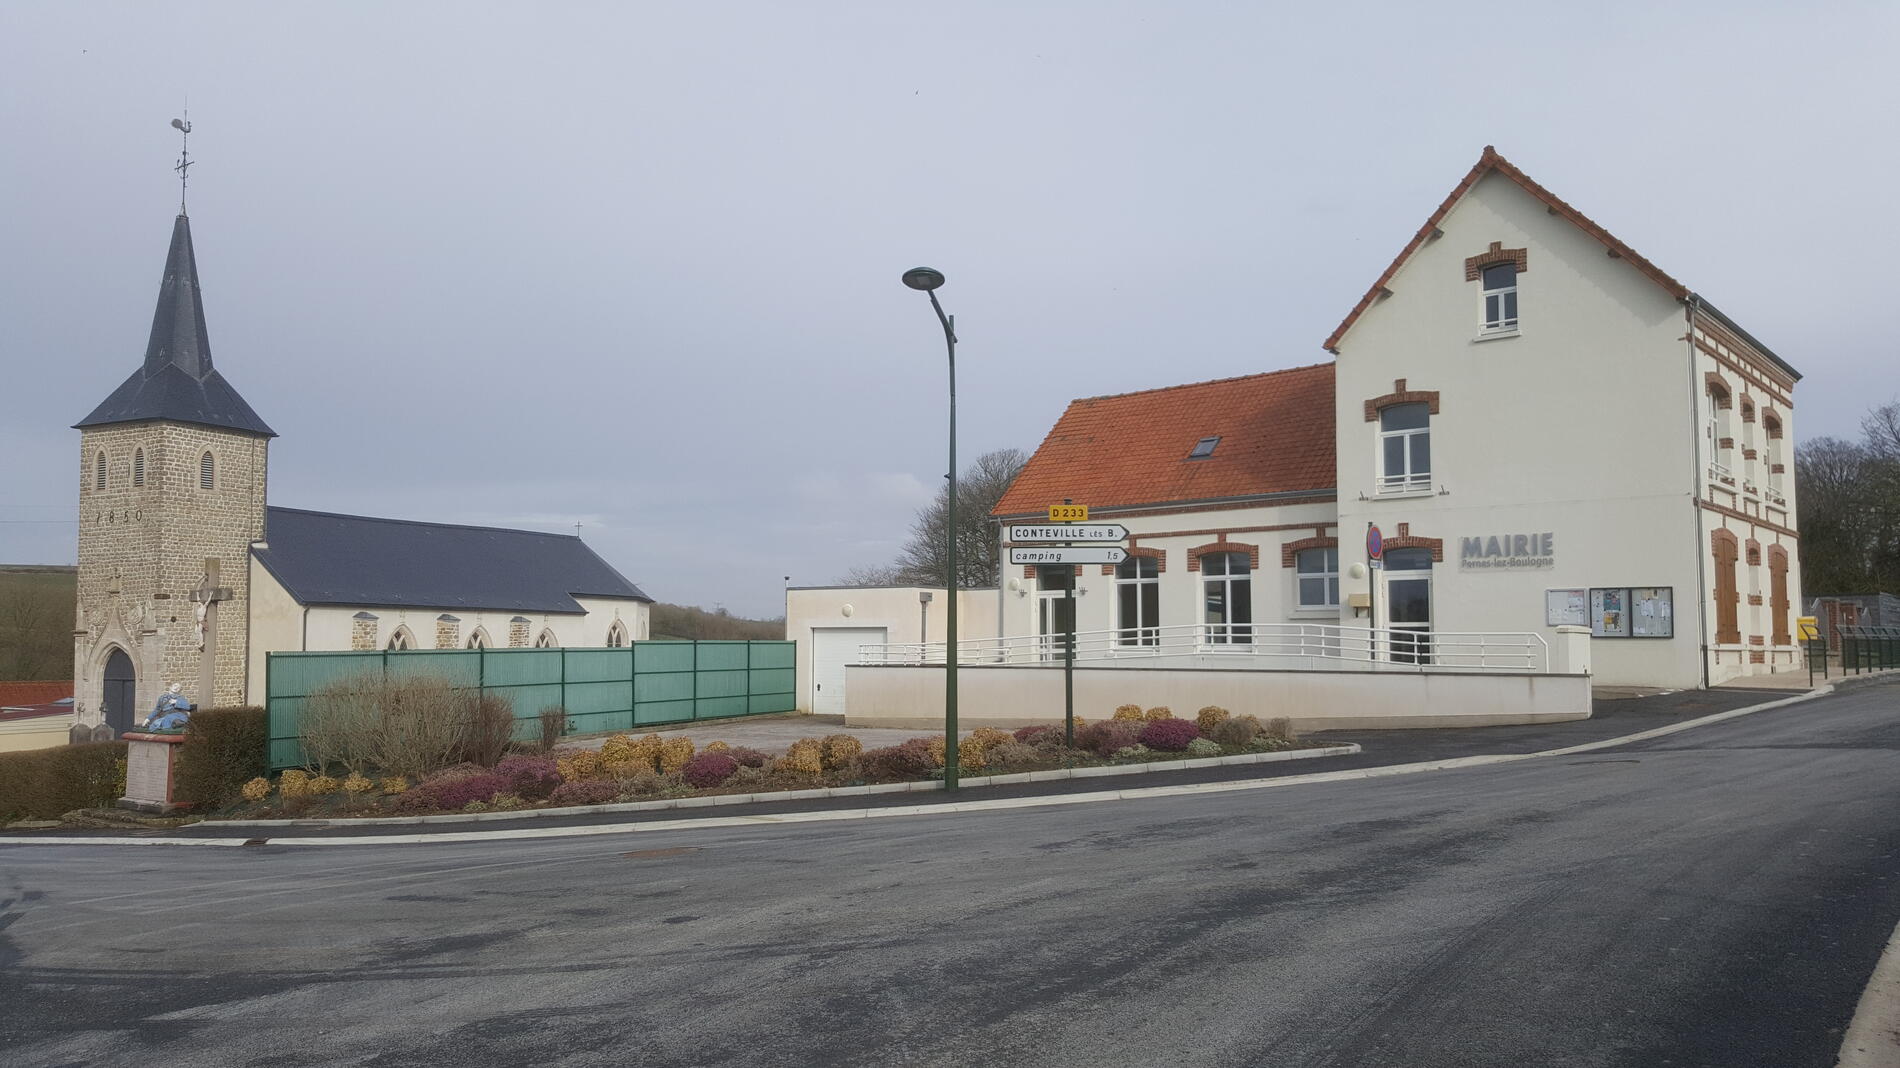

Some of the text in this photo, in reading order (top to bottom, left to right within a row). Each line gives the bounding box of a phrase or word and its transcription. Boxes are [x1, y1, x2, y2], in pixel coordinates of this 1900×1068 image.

[96, 510, 142, 525] 1850
[1053, 509, 1084, 517] D 233
[1015, 529, 1085, 538] CONTEVILLE
[1107, 528, 1118, 538] B.
[1461, 532, 1554, 558] MAIRIE
[1015, 551, 1062, 562] camping
